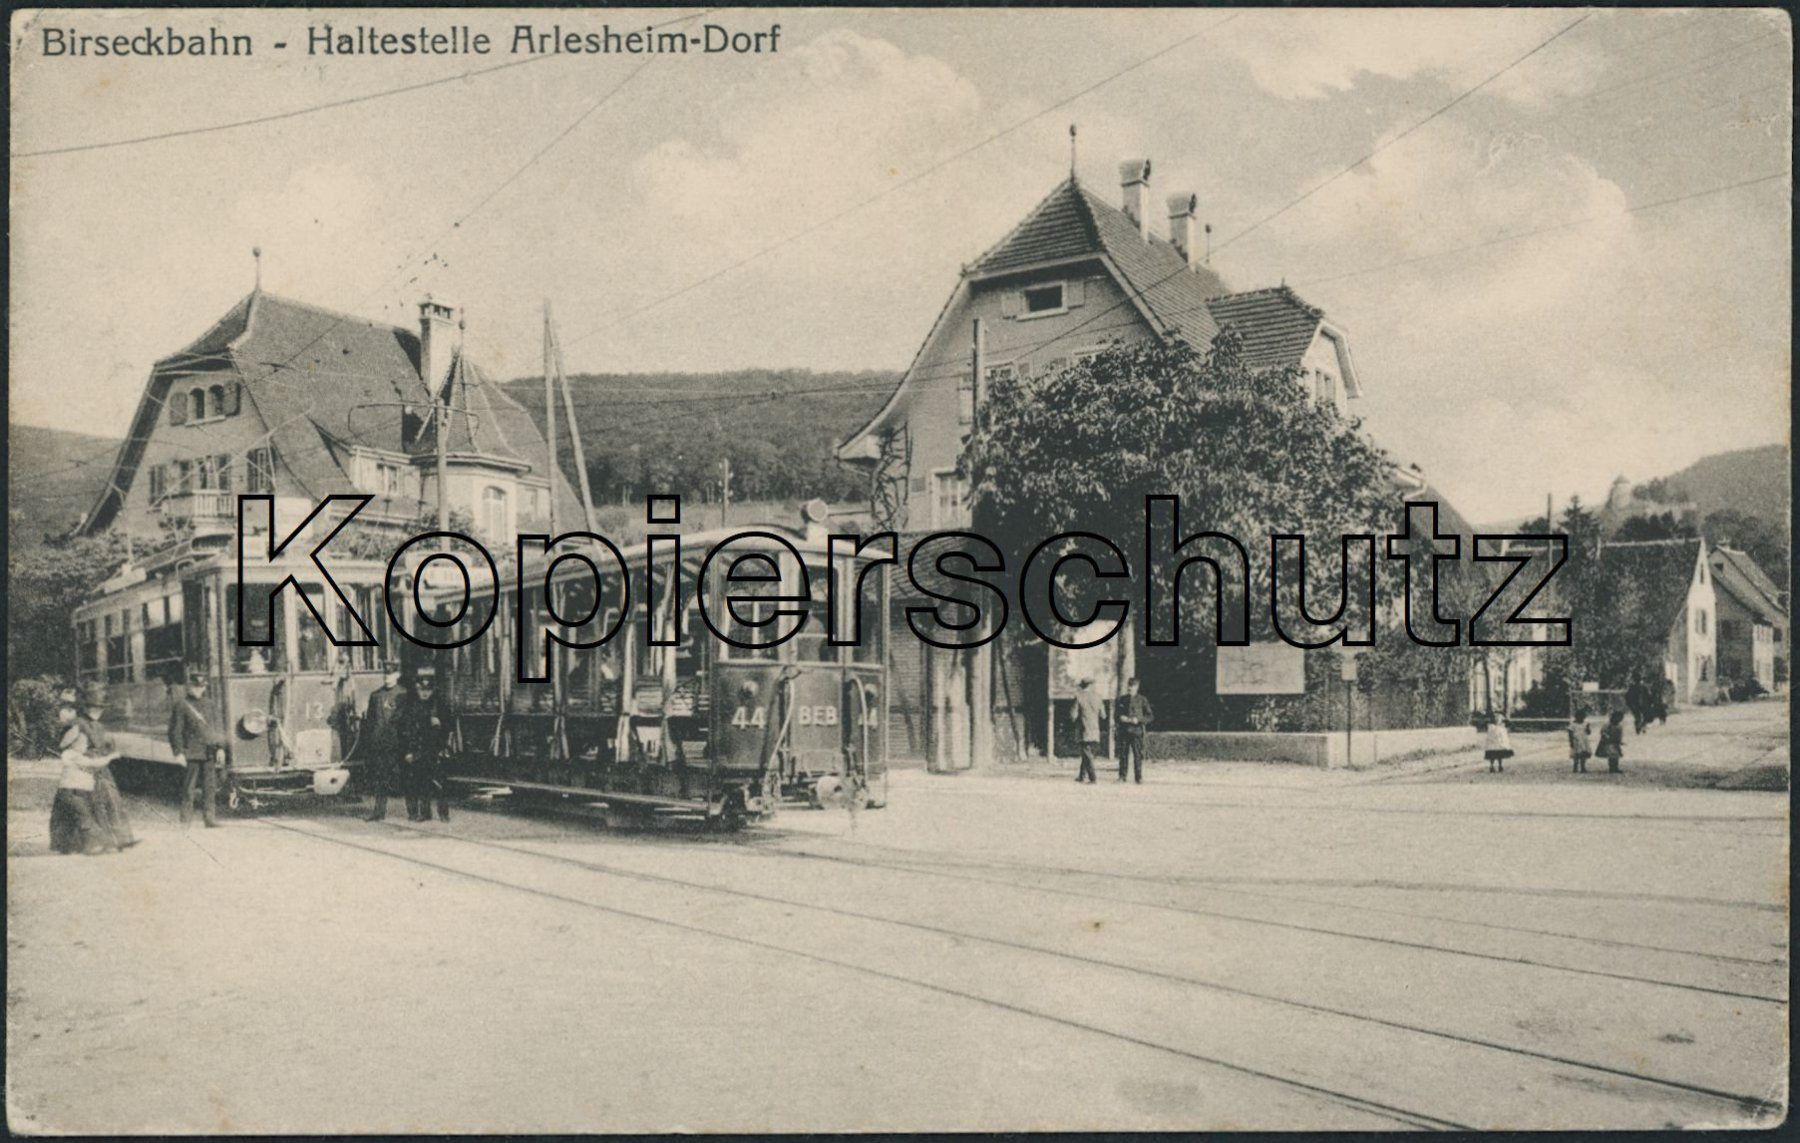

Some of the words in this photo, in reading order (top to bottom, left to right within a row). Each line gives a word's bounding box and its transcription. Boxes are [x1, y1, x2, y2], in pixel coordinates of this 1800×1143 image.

[306, 702, 323, 719] 13
[731, 706, 767, 730] 44
[799, 706, 838, 726] BEB
